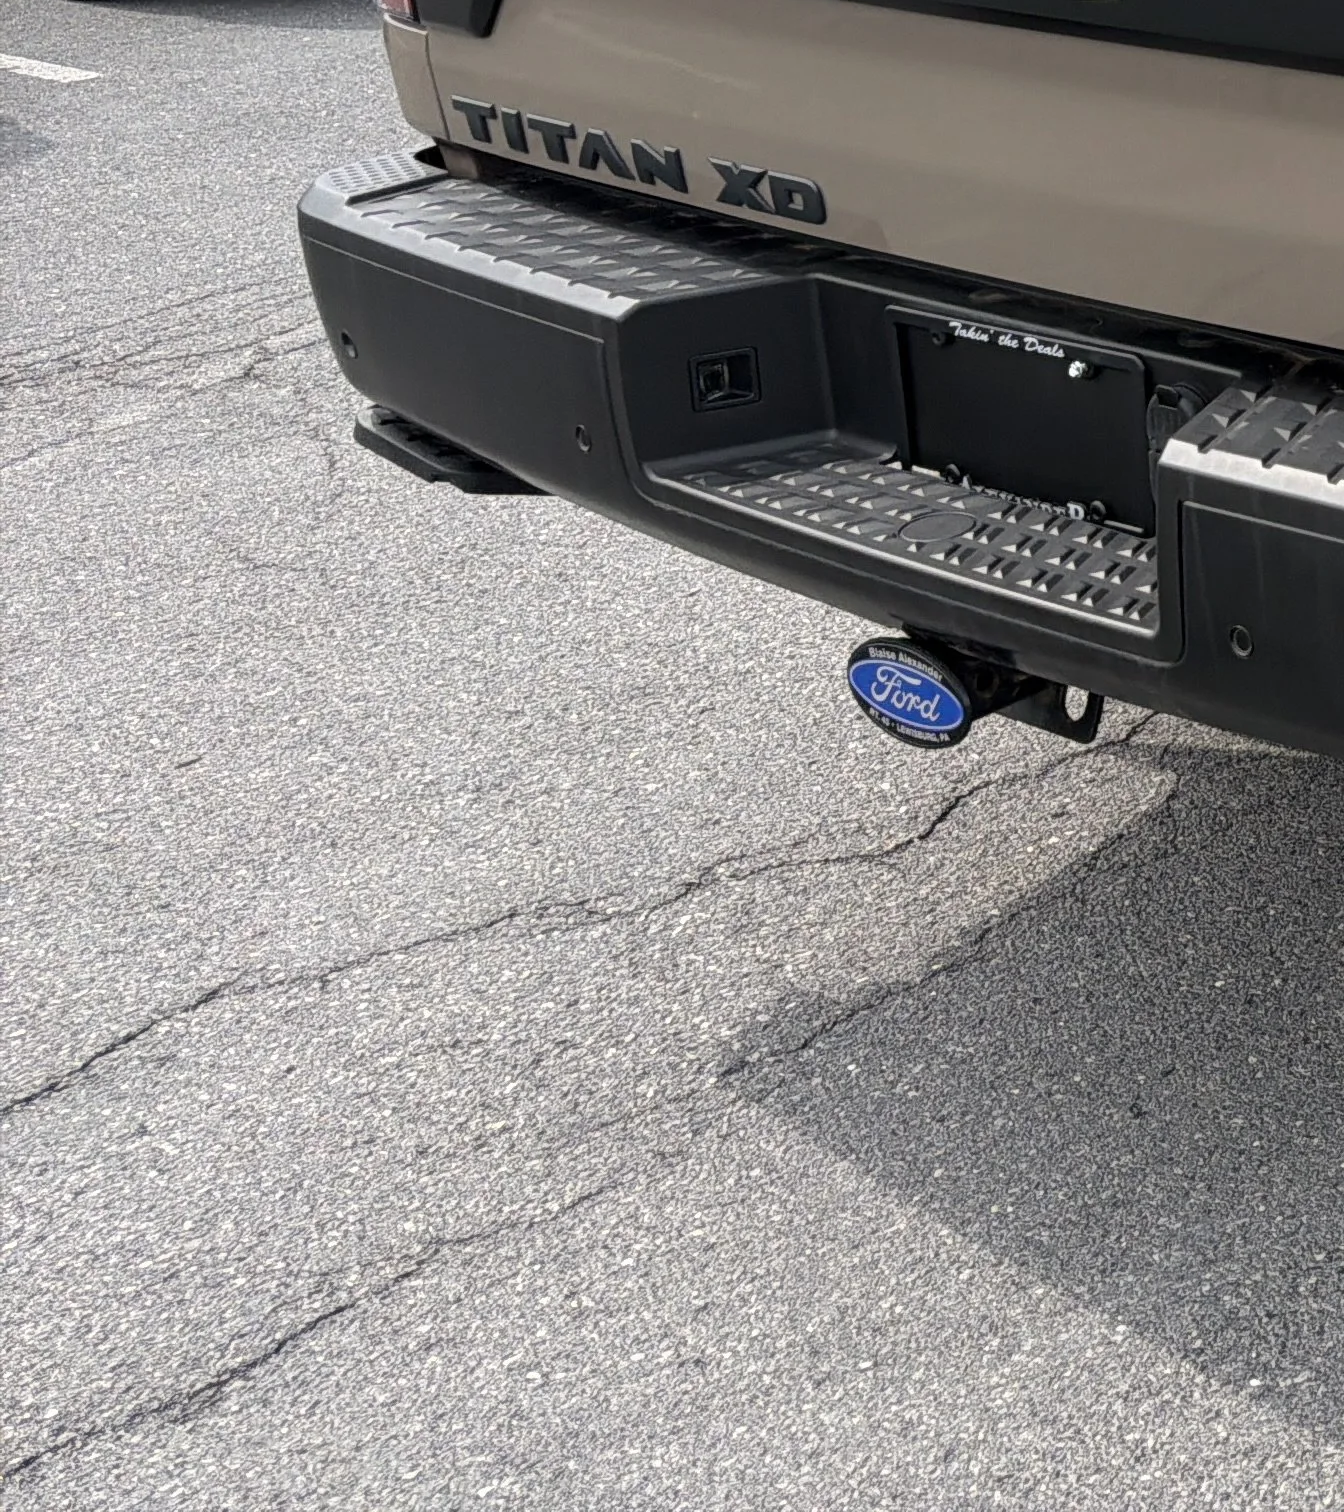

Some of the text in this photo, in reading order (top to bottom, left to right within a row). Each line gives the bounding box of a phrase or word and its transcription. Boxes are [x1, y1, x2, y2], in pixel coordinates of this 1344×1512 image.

[451, 94, 827, 225] TITAN XD
[949, 321, 1065, 358] Takin' the Deals
[871, 665, 940, 722] Ford
